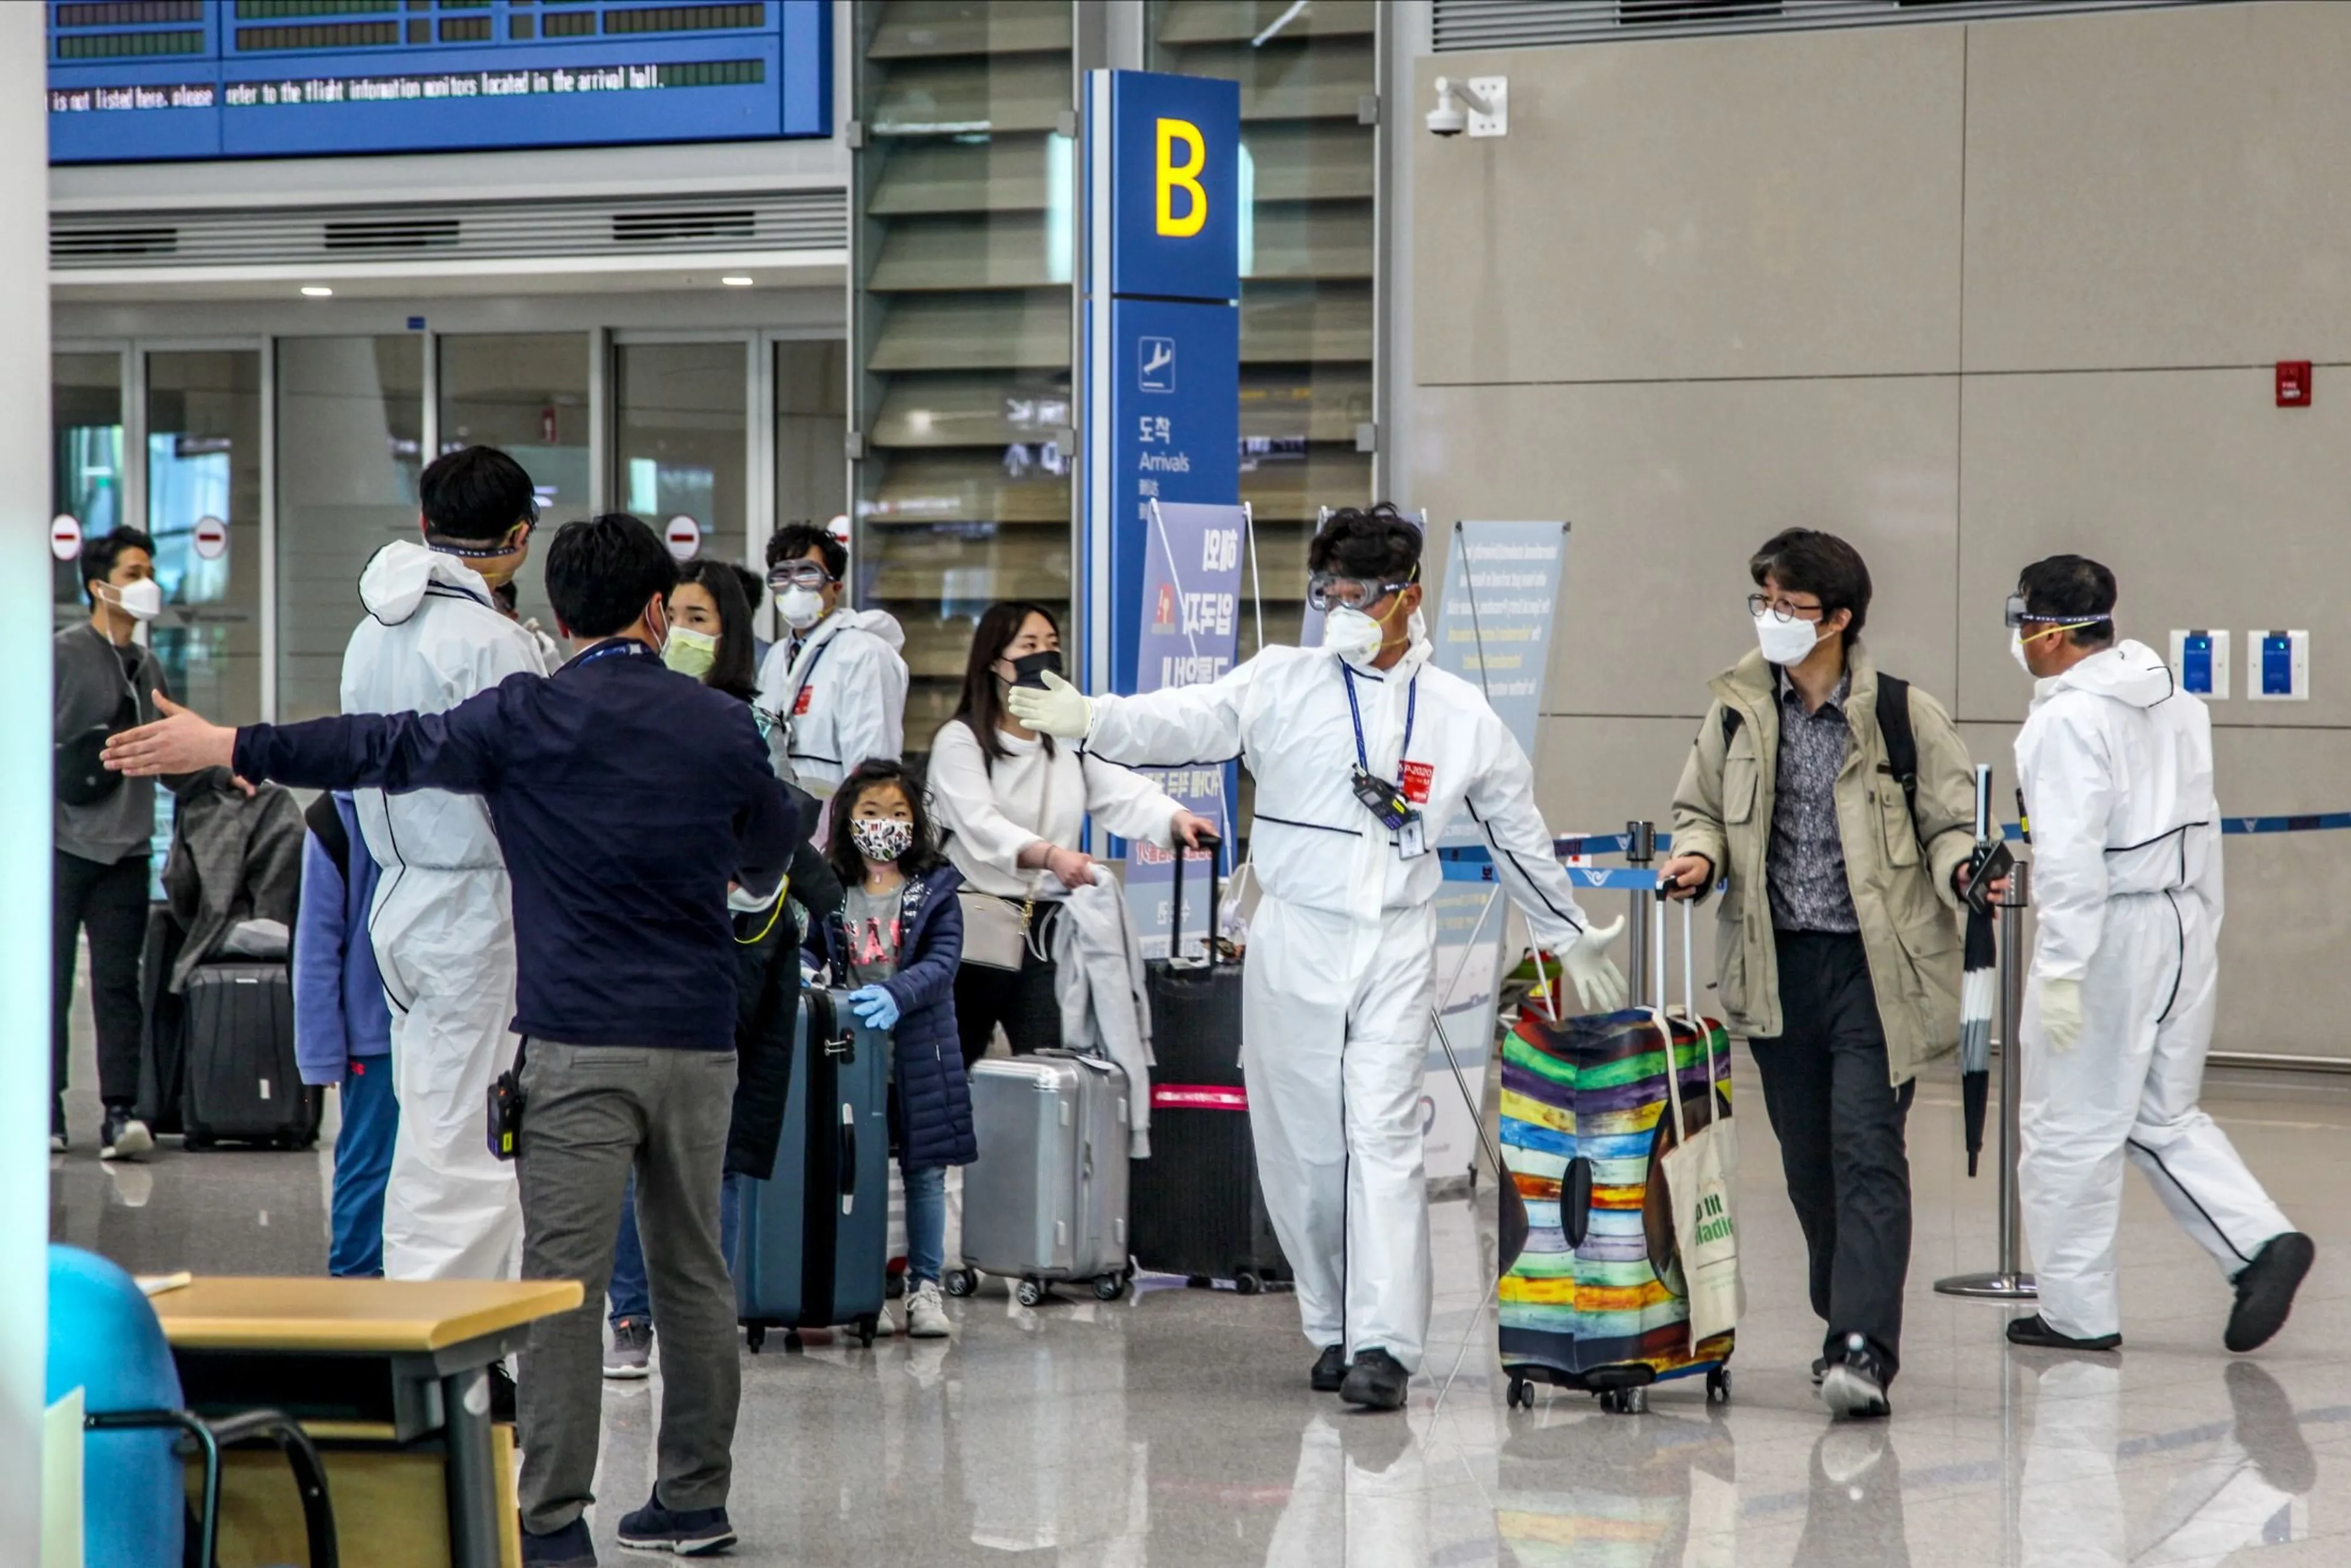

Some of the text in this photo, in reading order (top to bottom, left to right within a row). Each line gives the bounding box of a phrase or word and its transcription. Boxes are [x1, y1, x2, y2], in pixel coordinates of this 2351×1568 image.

[53, 96, 67, 111] is
[70, 92, 89, 111] not
[96, 88, 133, 109] listed
[172, 85, 213, 107] please
[225, 84, 256, 105] refer
[262, 84, 276, 103] to
[280, 81, 300, 103] the
[305, 79, 343, 102] flight
[349, 78, 420, 100] information
[423, 75, 478, 98] monitors
[481, 71, 529, 95] located
[533, 72, 549, 92] in
[552, 69, 574, 92] the
[577, 66, 624, 91] arrival
[1156, 116, 1209, 238] B
[1138, 415, 1171, 445] 도착
[1138, 451, 1191, 473] Arrivals
